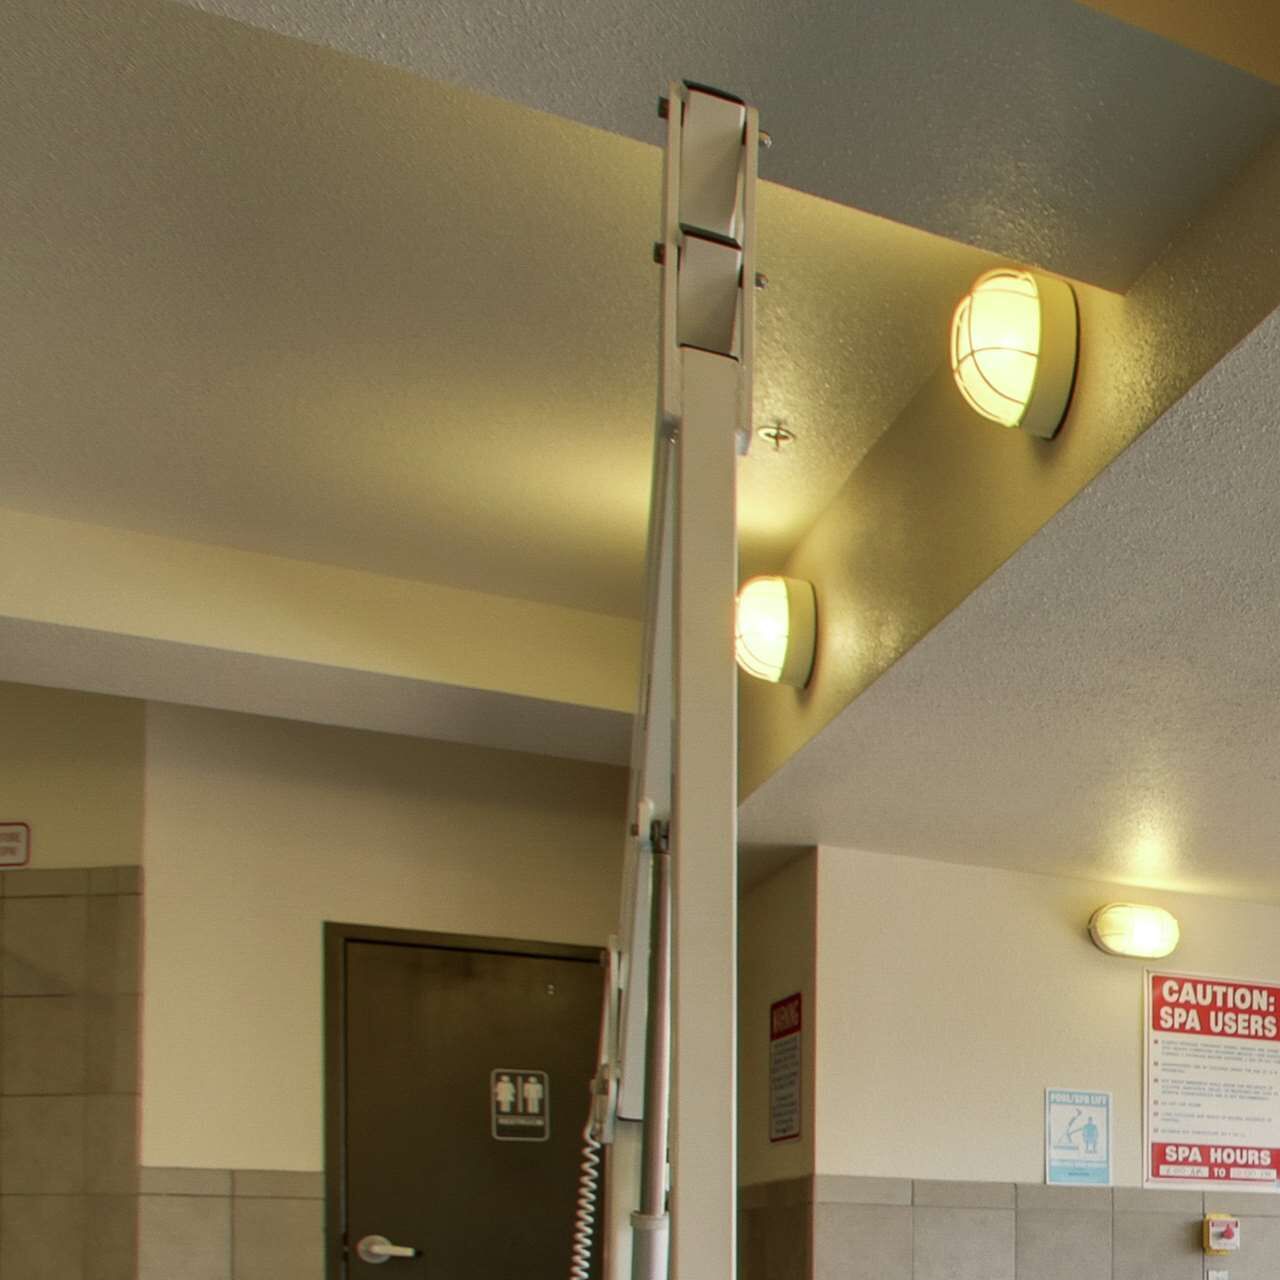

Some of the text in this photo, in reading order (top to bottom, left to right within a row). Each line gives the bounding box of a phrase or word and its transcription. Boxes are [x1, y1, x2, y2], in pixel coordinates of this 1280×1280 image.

[1162, 980, 1275, 1012] CAUTION:
[1160, 1006, 1277, 1038] SPA USERS
[1165, 1145, 1271, 1165] SPA HOURS
[1213, 1167, 1226, 1178] TO
